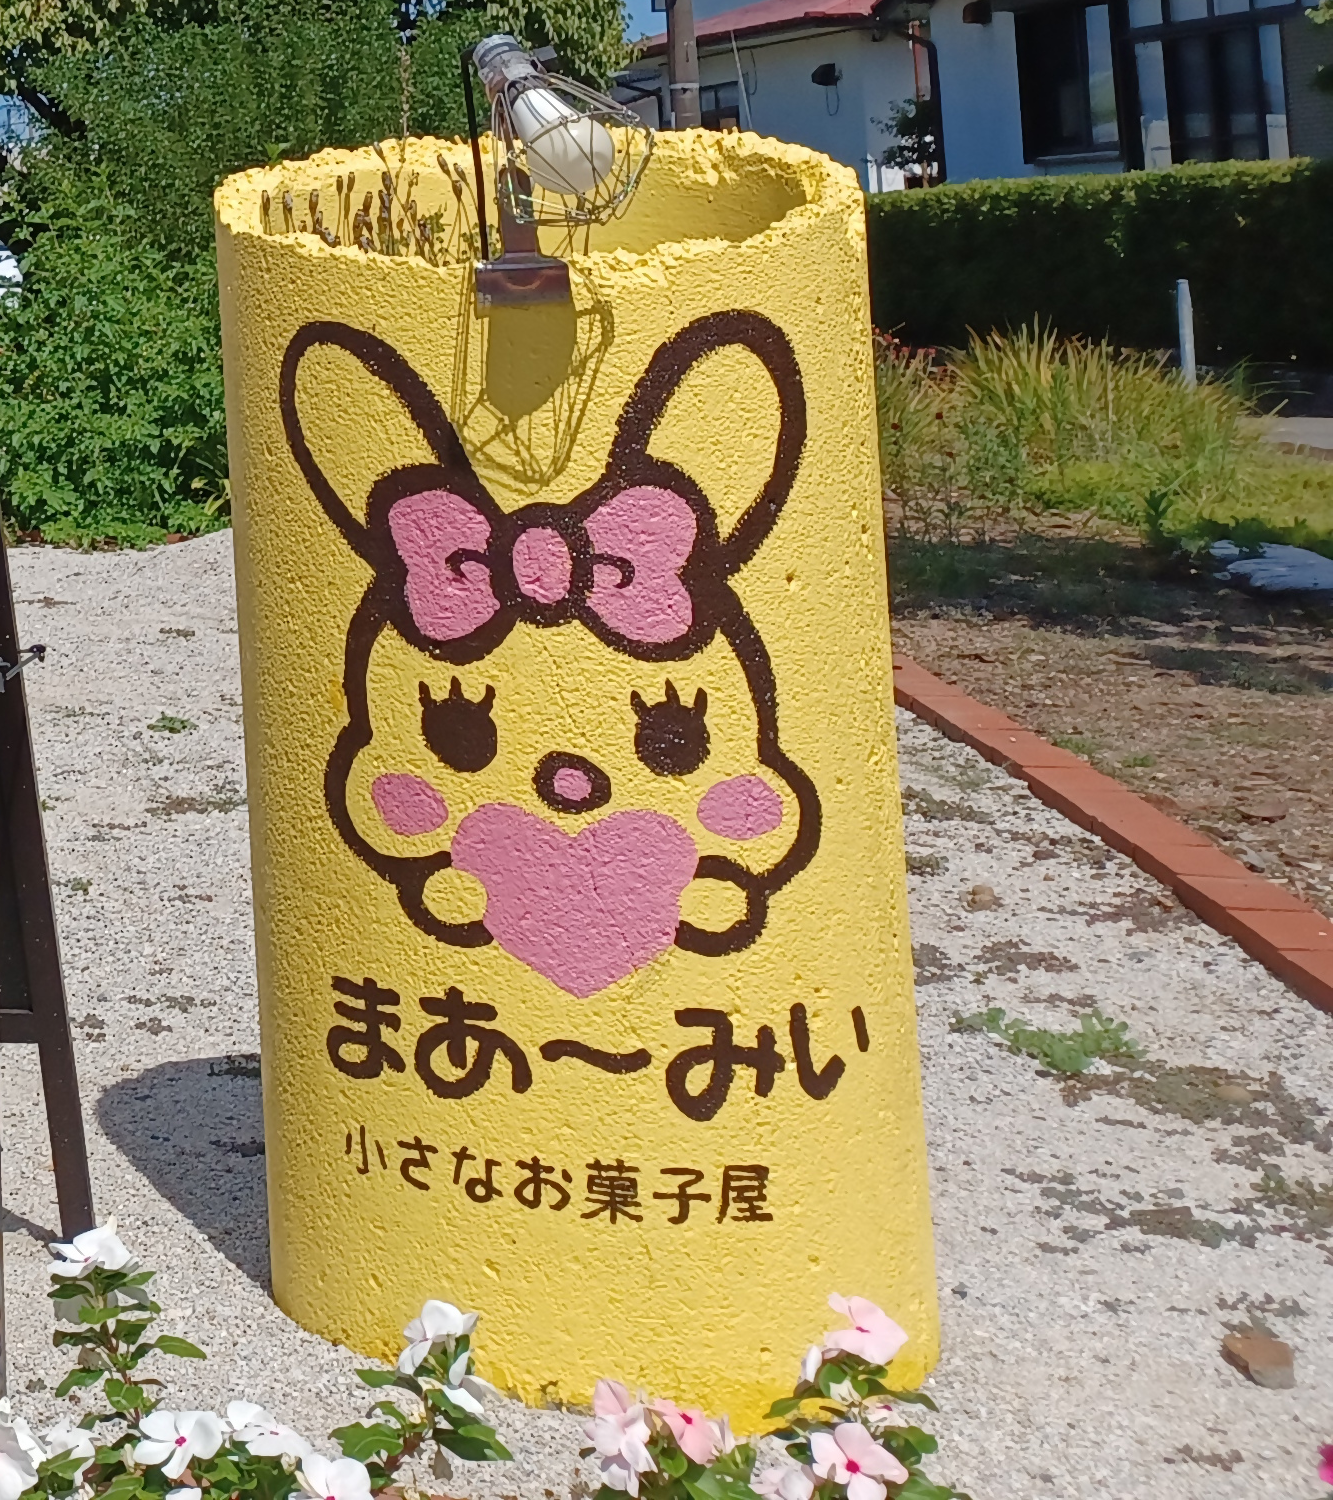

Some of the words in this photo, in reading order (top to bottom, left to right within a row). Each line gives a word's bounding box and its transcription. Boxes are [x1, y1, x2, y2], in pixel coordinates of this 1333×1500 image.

[342, 1125, 775, 1225] 小さなお菓子屋
